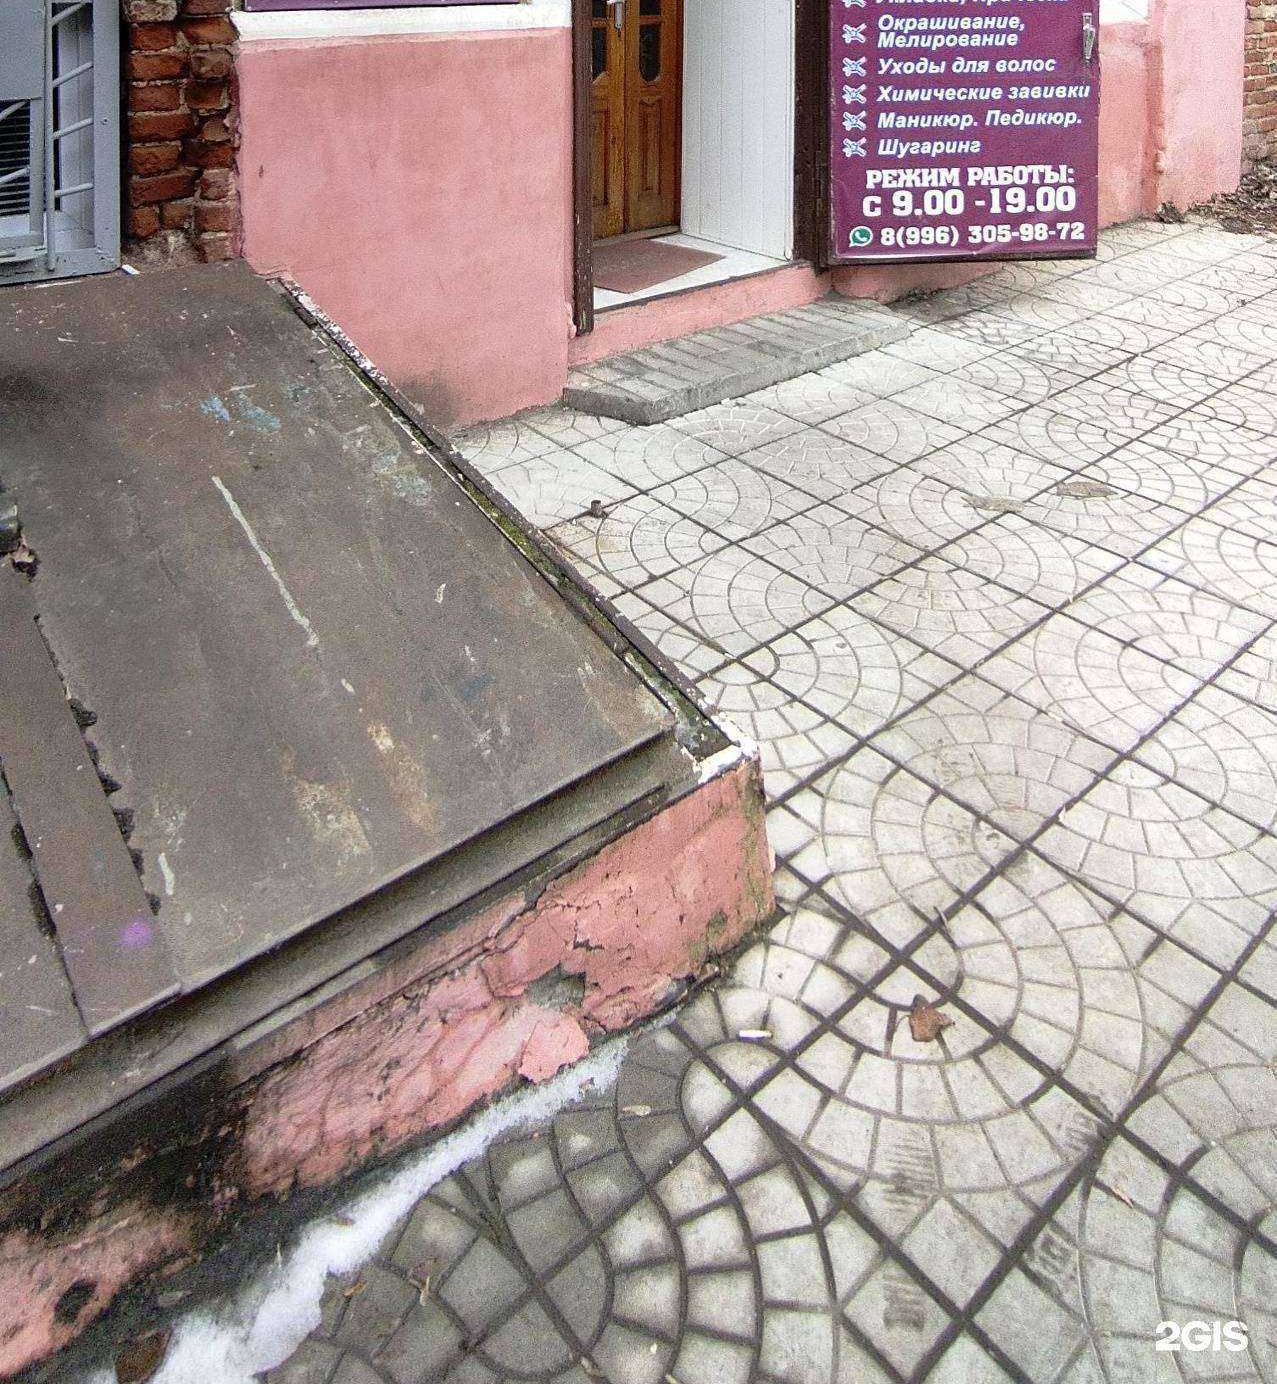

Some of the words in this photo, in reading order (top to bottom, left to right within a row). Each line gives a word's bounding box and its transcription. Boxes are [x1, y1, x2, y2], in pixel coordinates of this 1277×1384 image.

[877, 14, 1025, 31] Окрашивание,
[877, 31, 1018, 50] Мелирование
[877, 58, 946, 75] Уходы
[952, 58, 989, 73] для
[995, 58, 1056, 72] волос
[876, 85, 1003, 102] Химические
[1007, 84, 1090, 100] завивки
[877, 112, 978, 130] Маникюр.
[985, 109, 1082, 128] Педикюр.
[877, 138, 981, 158] Шугаринг
[865, 167, 960, 189] РЕЖИМ
[967, 164, 1075, 186] РАБОТЫ:
[892, 189, 965, 216] 9.00
[880, 225, 959, 248] 8(996)
[968, 222, 1085, 244] 305-98-72
